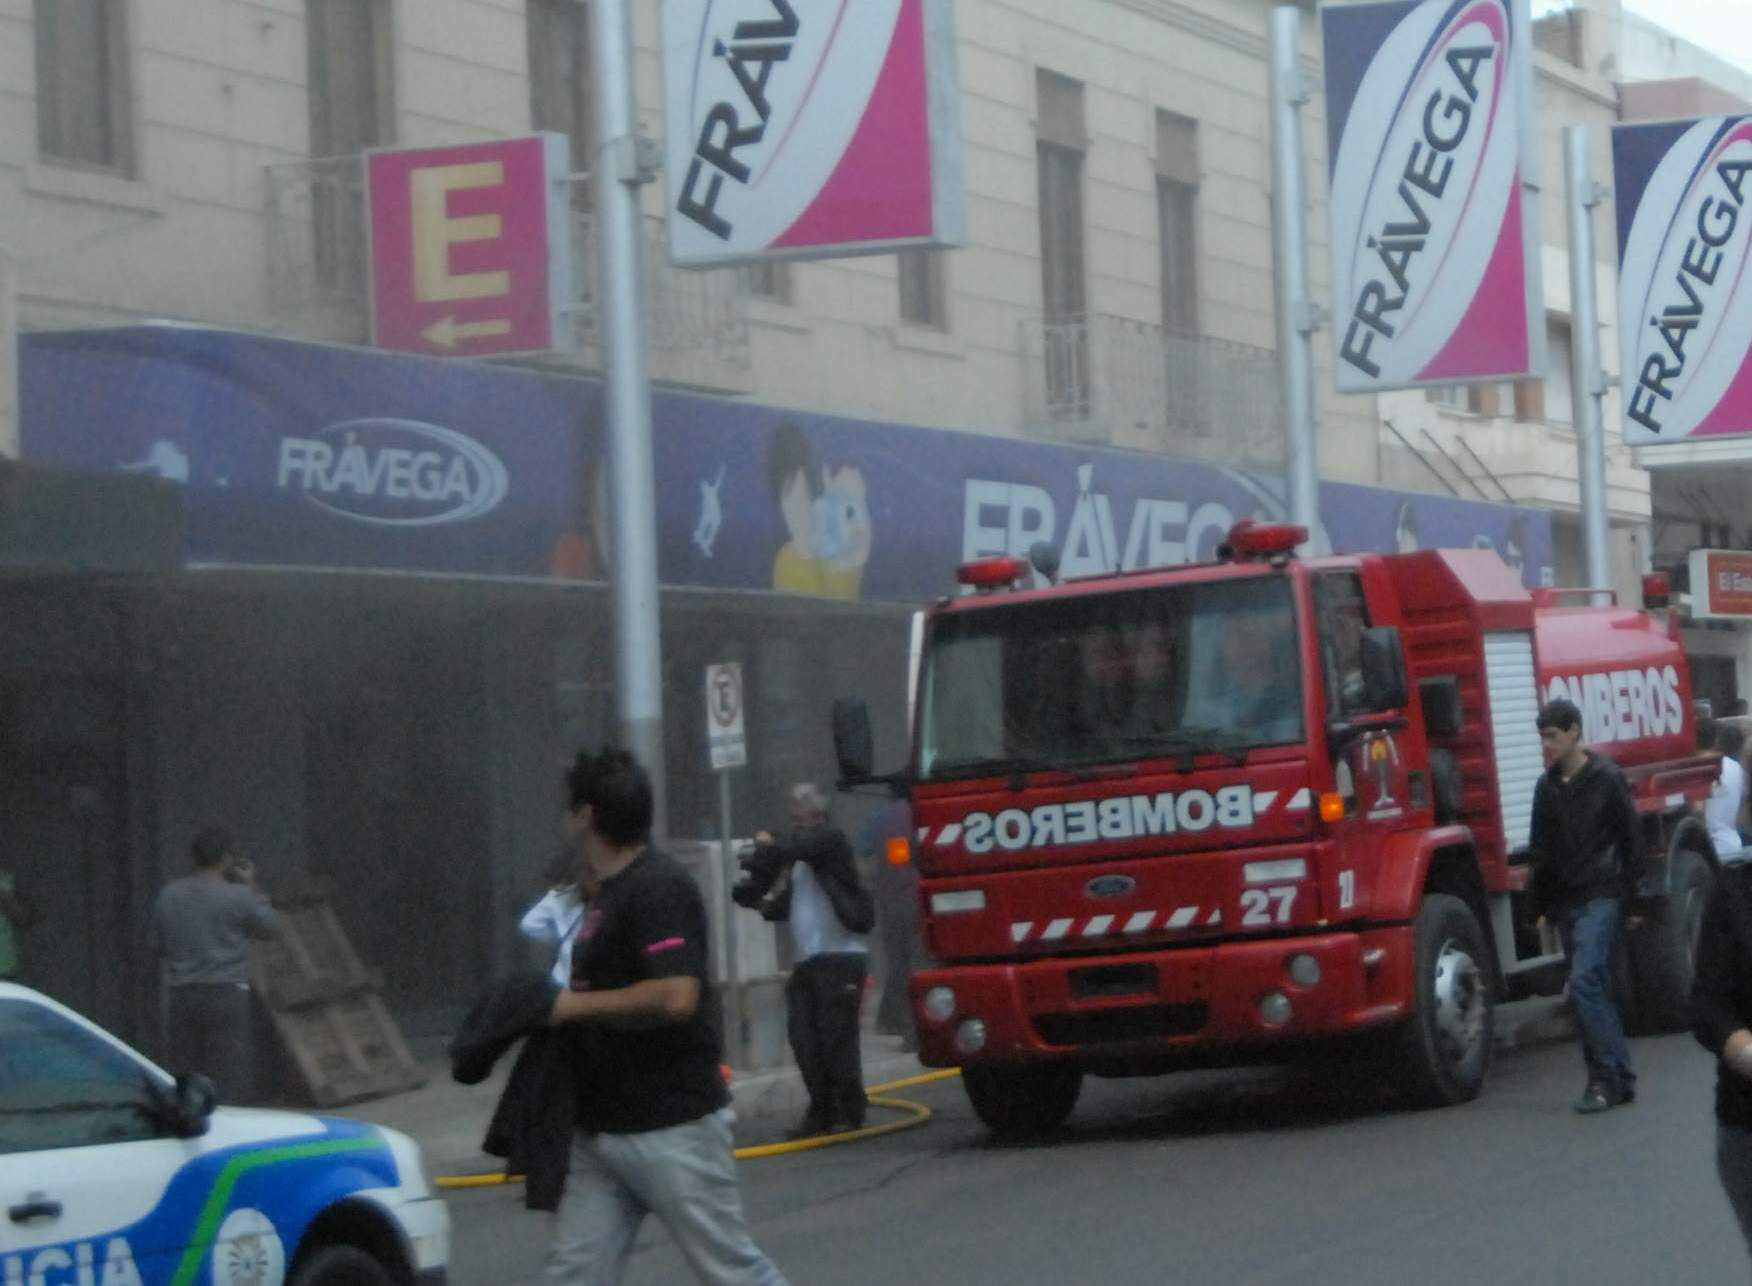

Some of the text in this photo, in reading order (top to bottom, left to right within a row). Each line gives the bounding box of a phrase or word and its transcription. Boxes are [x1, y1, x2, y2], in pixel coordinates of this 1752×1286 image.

[409, 160, 510, 303] E
[1340, 43, 1496, 379] FRÁVEGA
[277, 431, 473, 502] FRÁVEGA
[1240, 886, 1298, 926] 27
